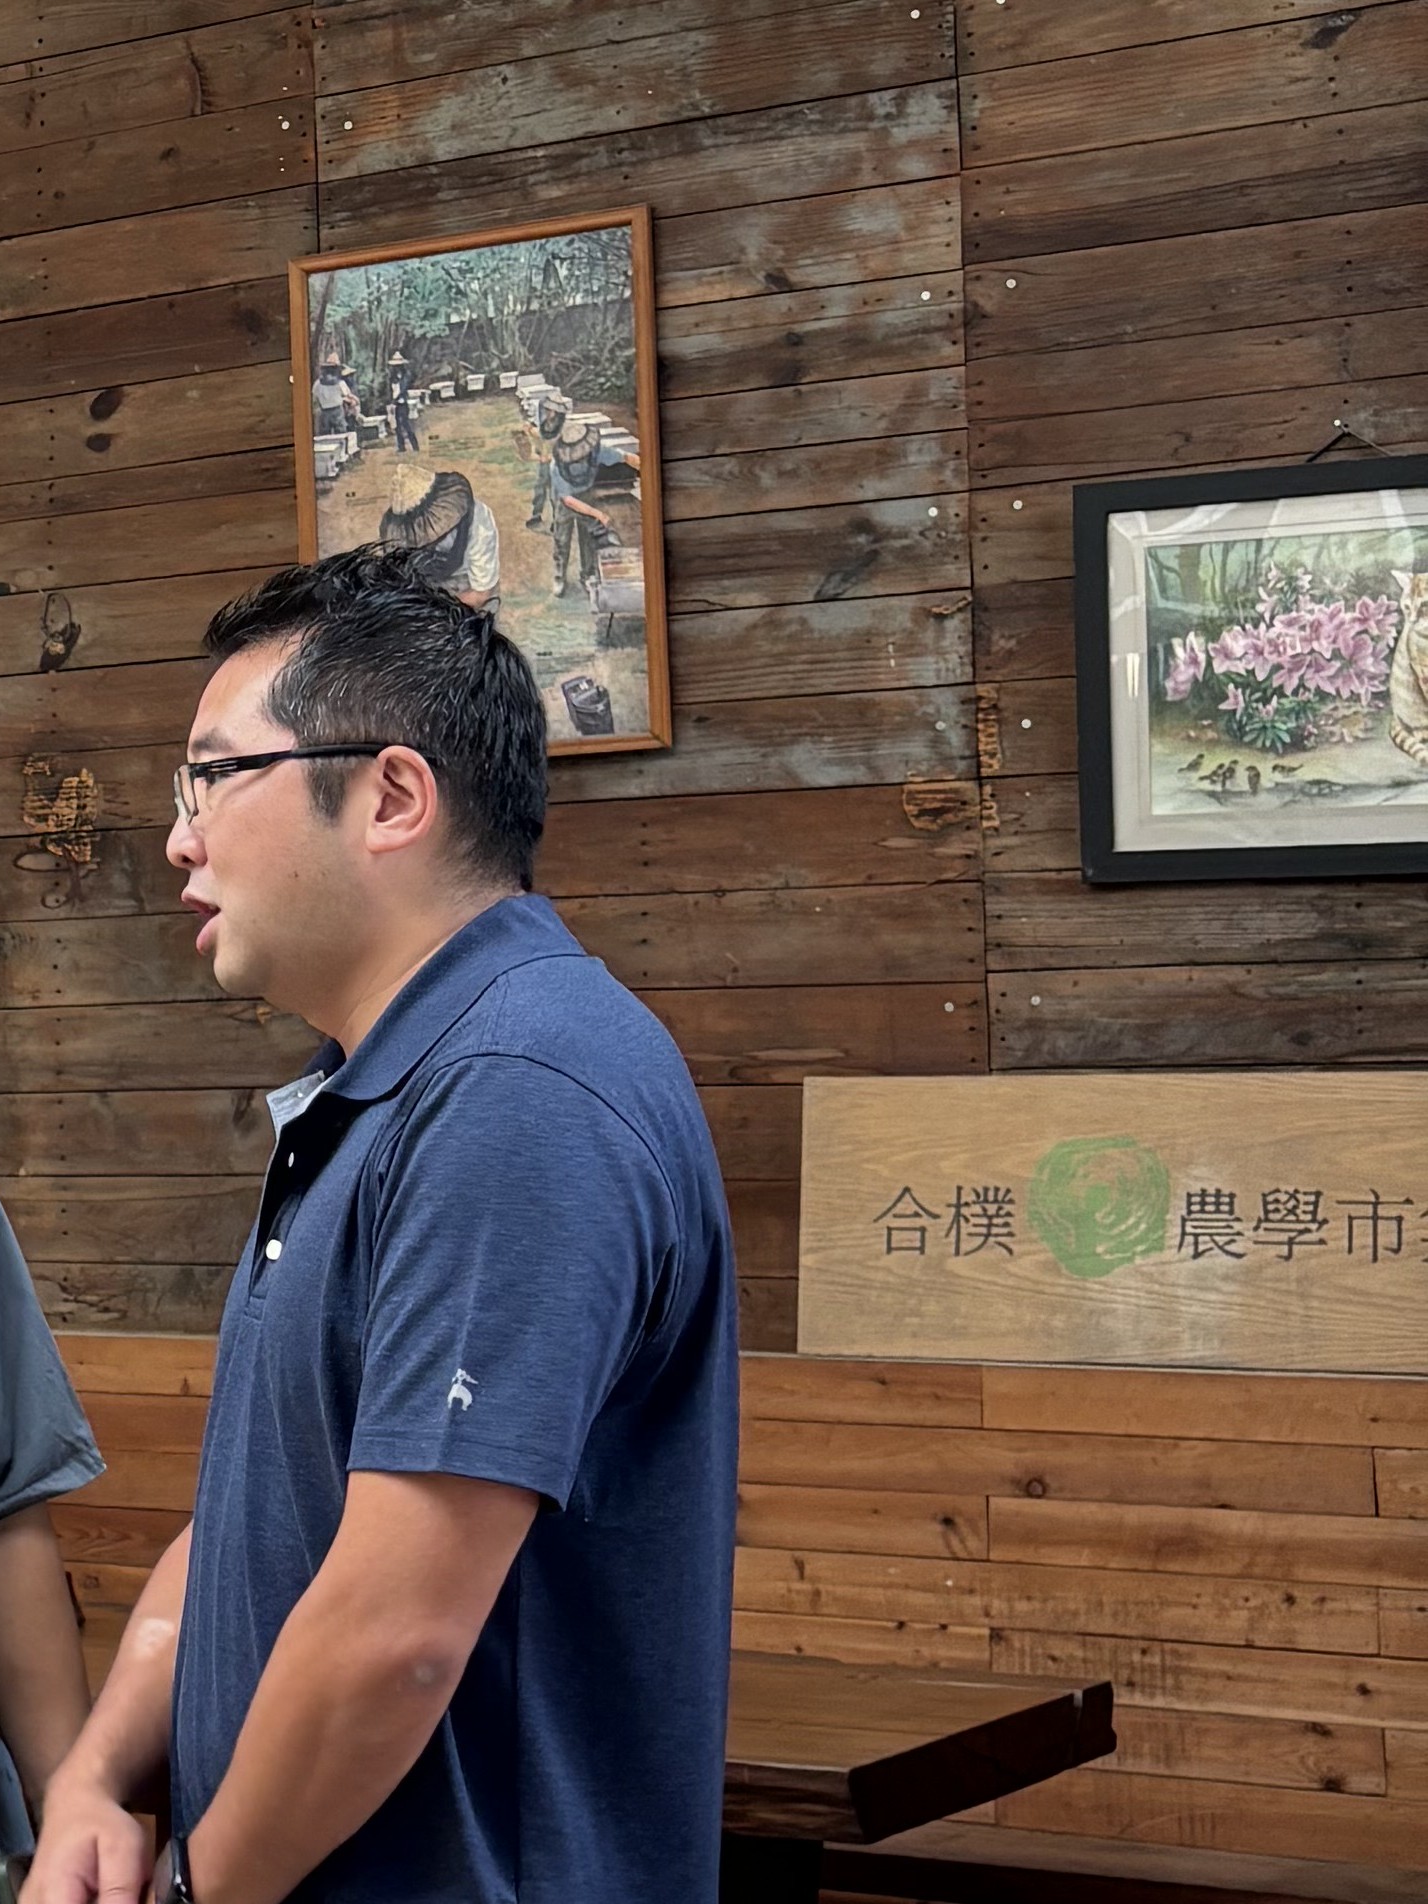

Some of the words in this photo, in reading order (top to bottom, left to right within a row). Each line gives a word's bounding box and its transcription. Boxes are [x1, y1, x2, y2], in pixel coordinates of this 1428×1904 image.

[872, 1185, 1015, 1257] 合樸
[1177, 1188, 1428, 1264] 農學市
